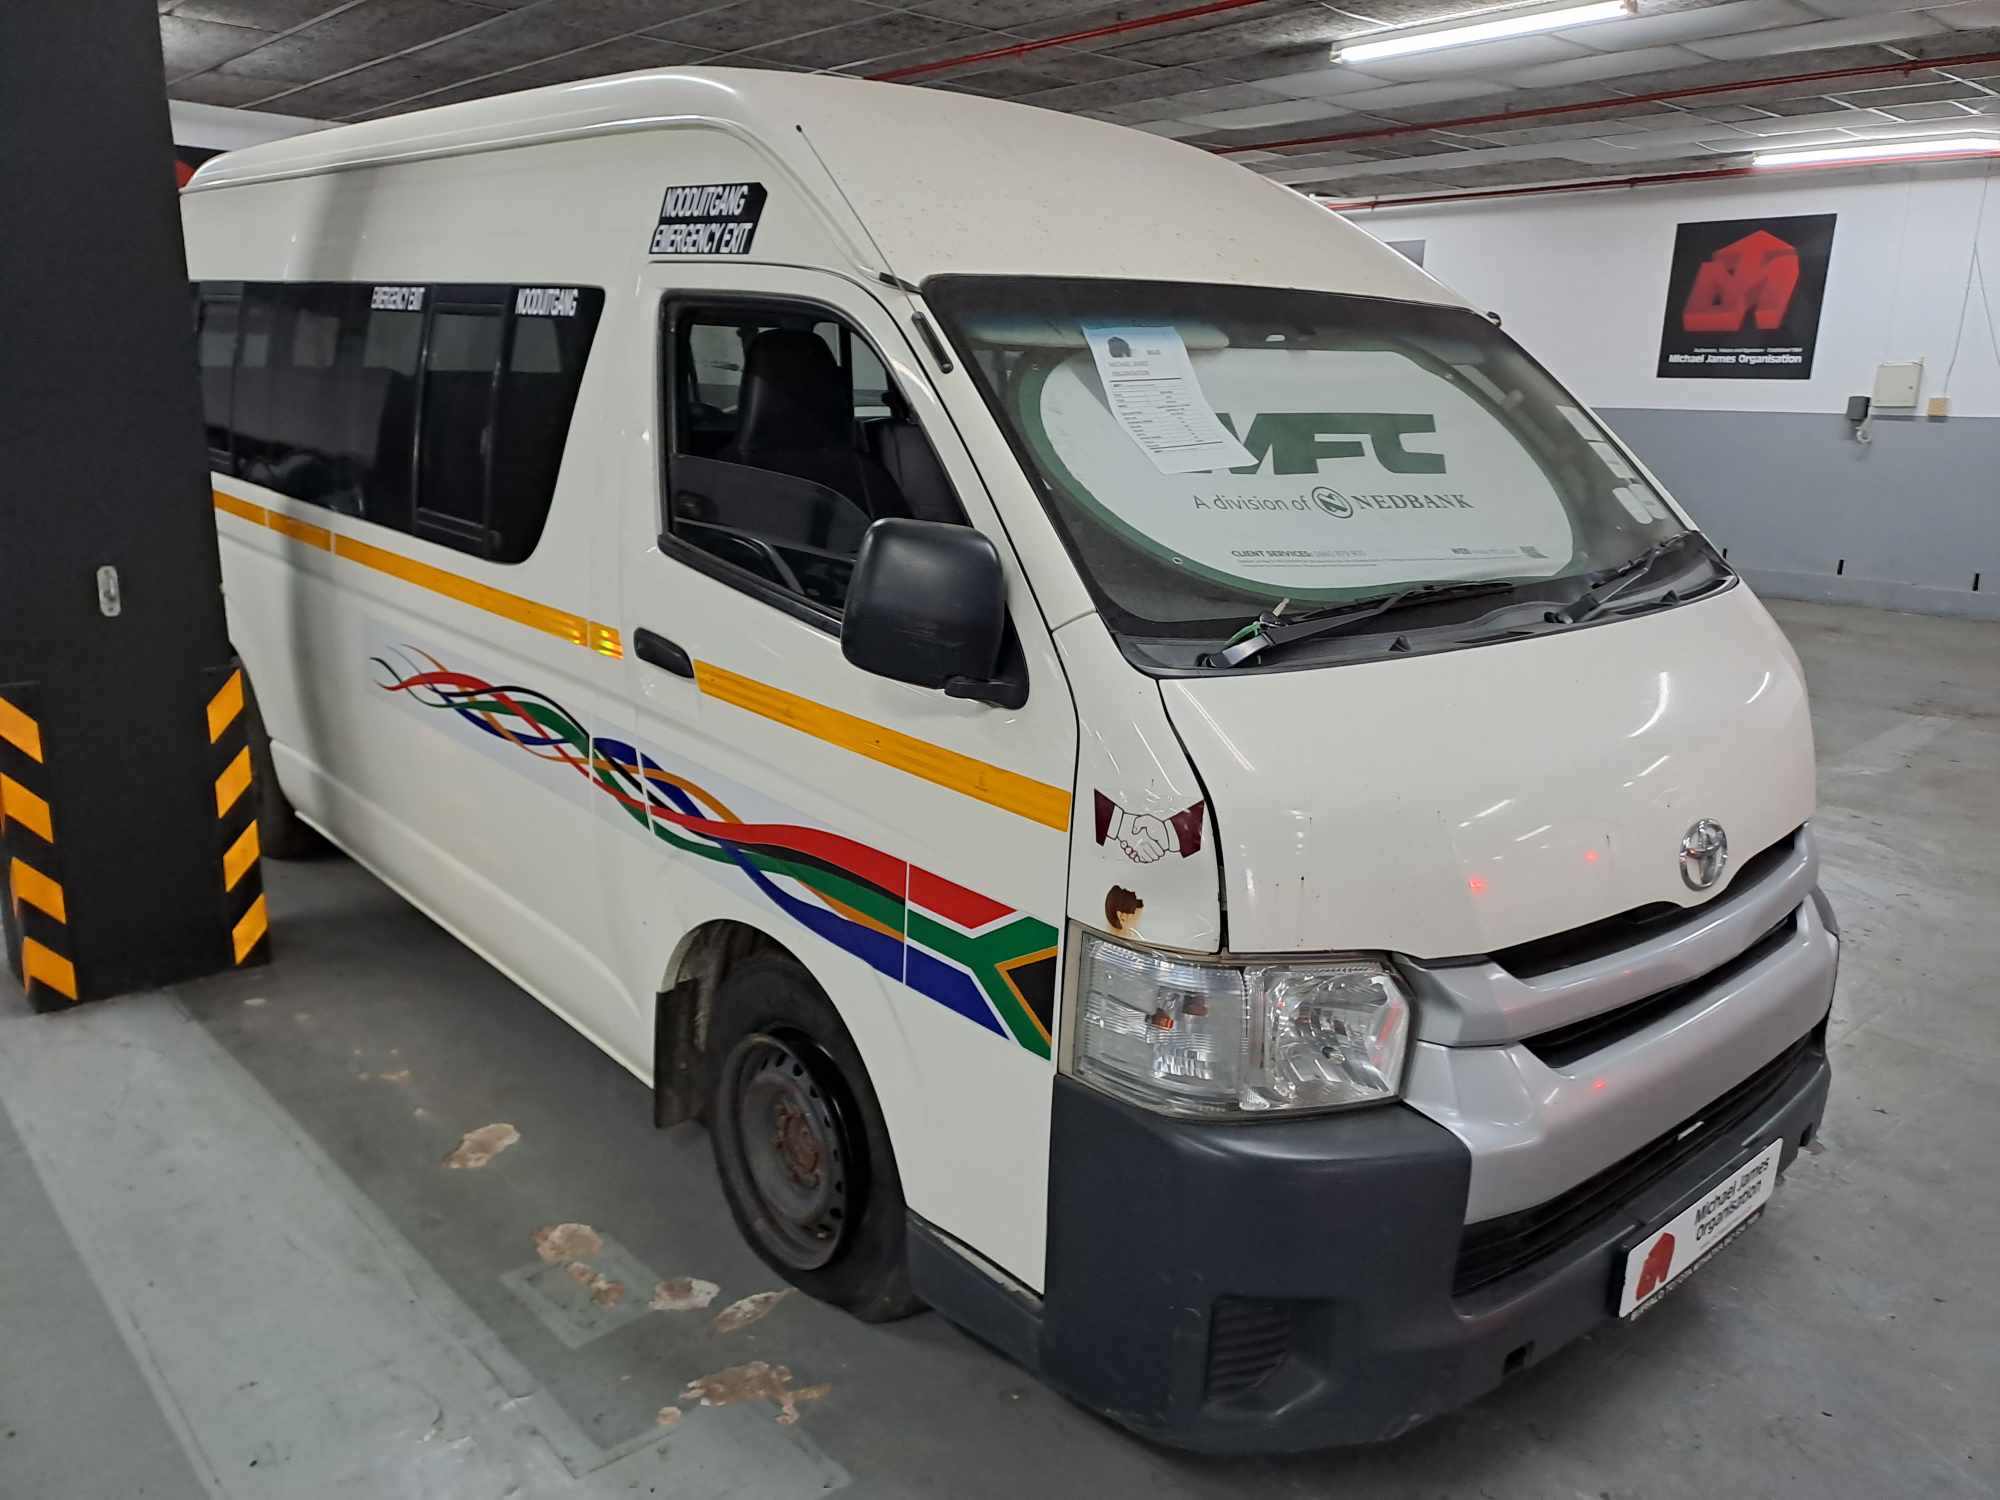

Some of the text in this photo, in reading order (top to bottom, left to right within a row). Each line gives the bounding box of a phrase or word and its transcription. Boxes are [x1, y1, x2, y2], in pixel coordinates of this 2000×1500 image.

[662, 184, 749, 218] NOODUITGANG
[651, 222, 754, 254] EMERGENCY EXIT
[514, 288, 579, 316] NOODUITGANG
[1668, 353, 1802, 365] Michael James Organisation
[1193, 494, 1475, 511] A division of NEDBANK
[1695, 1157, 1770, 1226] Michael James
[1696, 1179, 1763, 1241] Organisation
